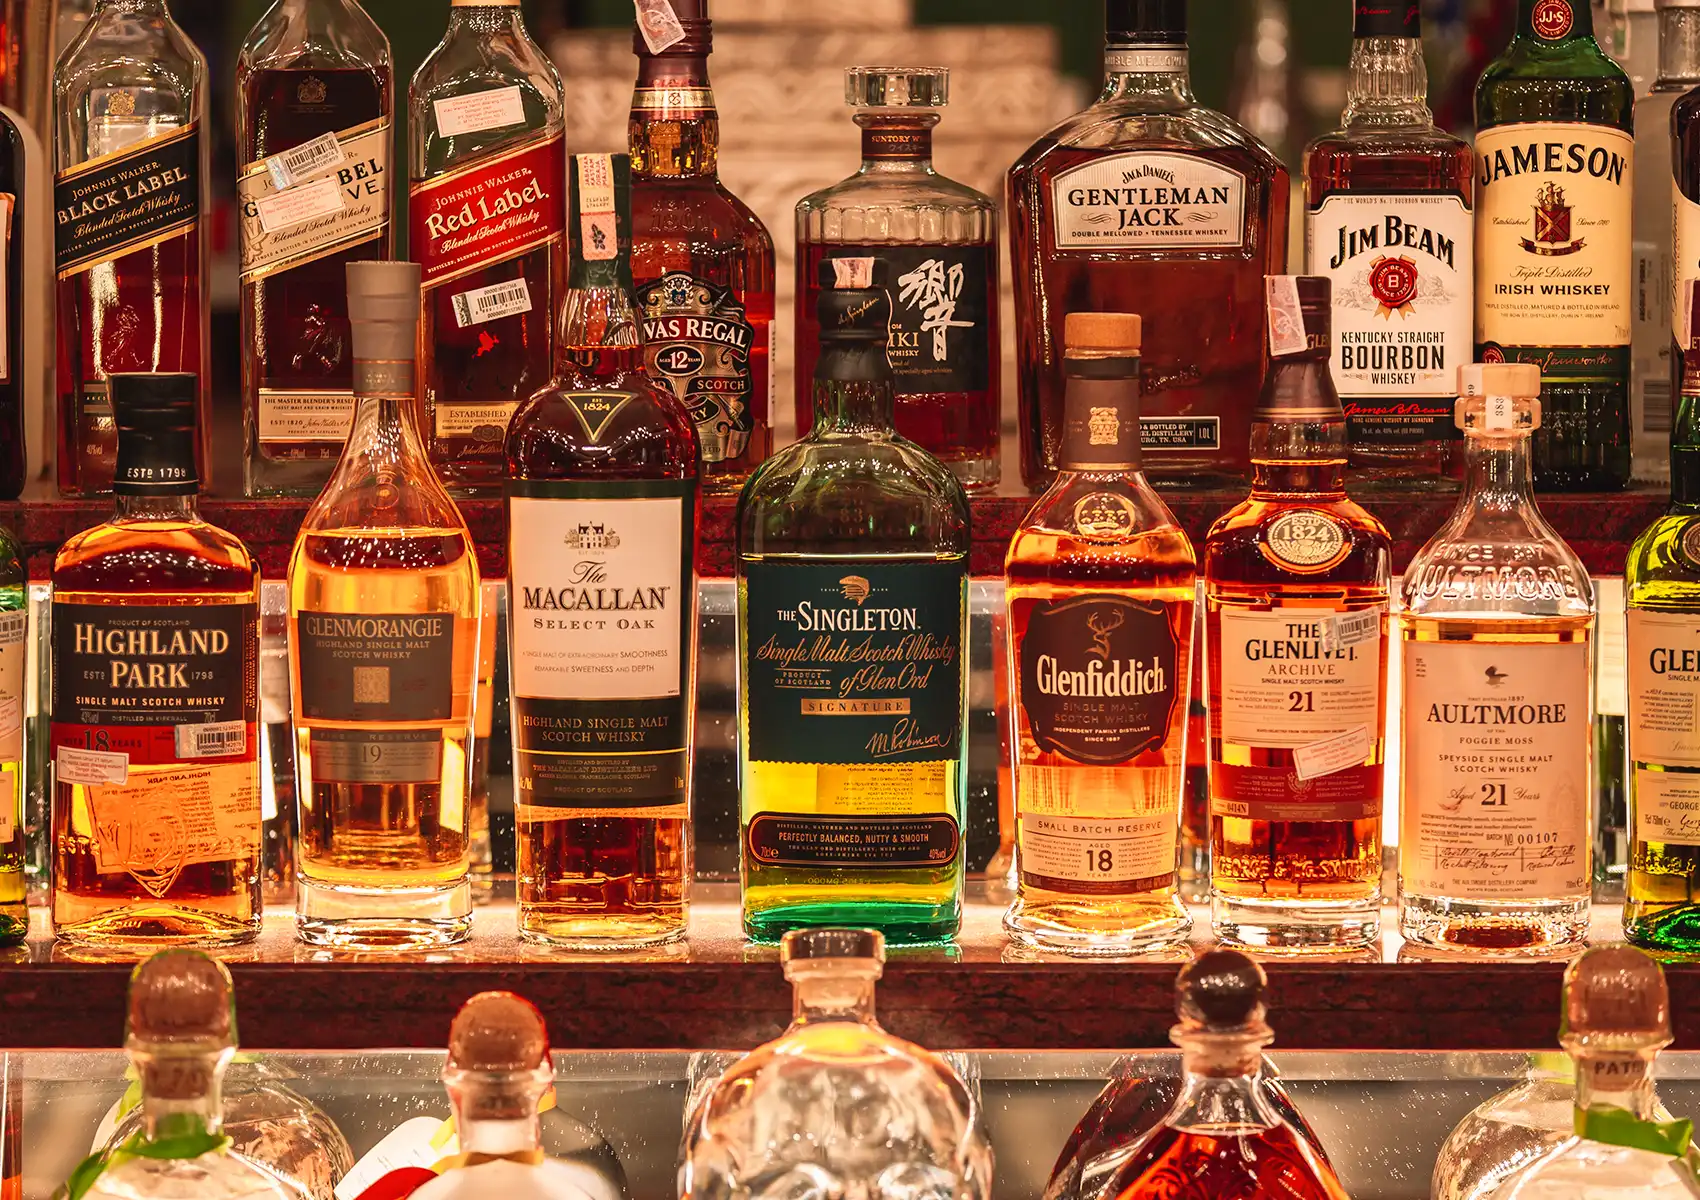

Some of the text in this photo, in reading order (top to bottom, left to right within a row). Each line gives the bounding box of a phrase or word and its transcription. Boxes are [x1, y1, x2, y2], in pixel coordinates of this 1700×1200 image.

[871, 135, 911, 143] SUNTORY
[1481, 143, 1624, 186] JAMESON
[72, 161, 159, 201] JOHNNIE WALKER
[1121, 164, 1176, 185] JACK DANIEL'S
[57, 167, 187, 225] BLACK LABEL
[435, 168, 528, 210] JOHNNIE WALKER
[1067, 187, 1230, 206] GENTLEMAN
[114, 191, 181, 225] Scotch Whisky
[308, 214, 337, 233] Scotch
[338, 203, 371, 223] Whisky
[424, 202, 478, 241] Red
[1117, 208, 1181, 230] JACK
[1492, 217, 1530, 226] Established
[478, 220, 507, 241] Scotch
[1330, 215, 1455, 270] JIM BEAM
[1510, 265, 1593, 282] Triple Distilled
[1388, 274, 1399, 288] B
[1495, 284, 1610, 296] IRISH WHISKEY
[643, 318, 747, 348] VAS REGAL
[889, 332, 920, 347] IKI
[1341, 331, 1393, 343] KENTUCKY
[1397, 331, 1445, 343] STRAIGHT
[670, 351, 689, 369] 12
[1342, 345, 1444, 370] BOURBON
[697, 379, 745, 390] SCOTCH
[1371, 372, 1416, 384] WHISKEY
[450, 410, 506, 418] ESTABLISHED
[583, 403, 611, 411] 1824
[159, 468, 187, 478] 1798
[1291, 517, 1321, 526] ESTD
[1282, 525, 1330, 541] 1824
[568, 560, 607, 585] The
[522, 586, 665, 611] MACALLAN
[776, 600, 917, 632] THE SINGLETON
[306, 617, 443, 638] GLENMORANGIE
[533, 618, 655, 630] SELECT OAK
[1286, 623, 1320, 638] THE
[74, 622, 229, 655] HIGHLAND
[316, 641, 431, 649] HIGHLAND SINGLE MALT
[332, 651, 411, 659] SCOTCH WHISKY
[619, 650, 668, 659] SMOOTHNESS
[755, 632, 956, 668] Single Malt Scotch Whisky
[109, 660, 190, 689] PARK
[191, 671, 214, 680] 1798
[571, 665, 614, 673] SWEETNESS
[631, 665, 655, 673] DEPTH
[1268, 664, 1336, 676] ARCHIVE
[838, 661, 934, 698] of Glen Ord
[1668, 674, 1691, 682] SINGLE
[75, 696, 225, 706] SINGLE MALT SCOTCH WHISKY
[808, 702, 904, 712] SIGNATURE
[1063, 702, 1140, 712] SINGLE MALT
[1288, 691, 1315, 712] 21
[1054, 713, 1149, 724] SCOTCH WHISKY
[1427, 703, 1566, 724] AULTMORE
[523, 716, 668, 729] HIGHLAND SINGLE MALT
[542, 731, 646, 743] SCOTCH WHISKY
[1053, 726, 1093, 734] INDEPENDENT
[1119, 726, 1151, 734] DISTILLERS
[84, 729, 110, 751] 18
[1459, 737, 1534, 745] FOGGIE MOSS
[361, 745, 382, 764] 19
[1438, 754, 1553, 763] SPEYSIDE SINGLE MALT
[1454, 765, 1494, 773] SCOTCH
[1481, 783, 1508, 806] 21
[1513, 787, 1541, 801] Years
[1669, 801, 1699, 810] GEORGE
[1038, 820, 1162, 834] SMALL BATCH RESERVE
[778, 832, 929, 844] PERFECTLY BALANCED, NUTTY SMOOTH
[1486, 832, 1559, 845] BATCH 00107
[1086, 849, 1113, 872] 18
